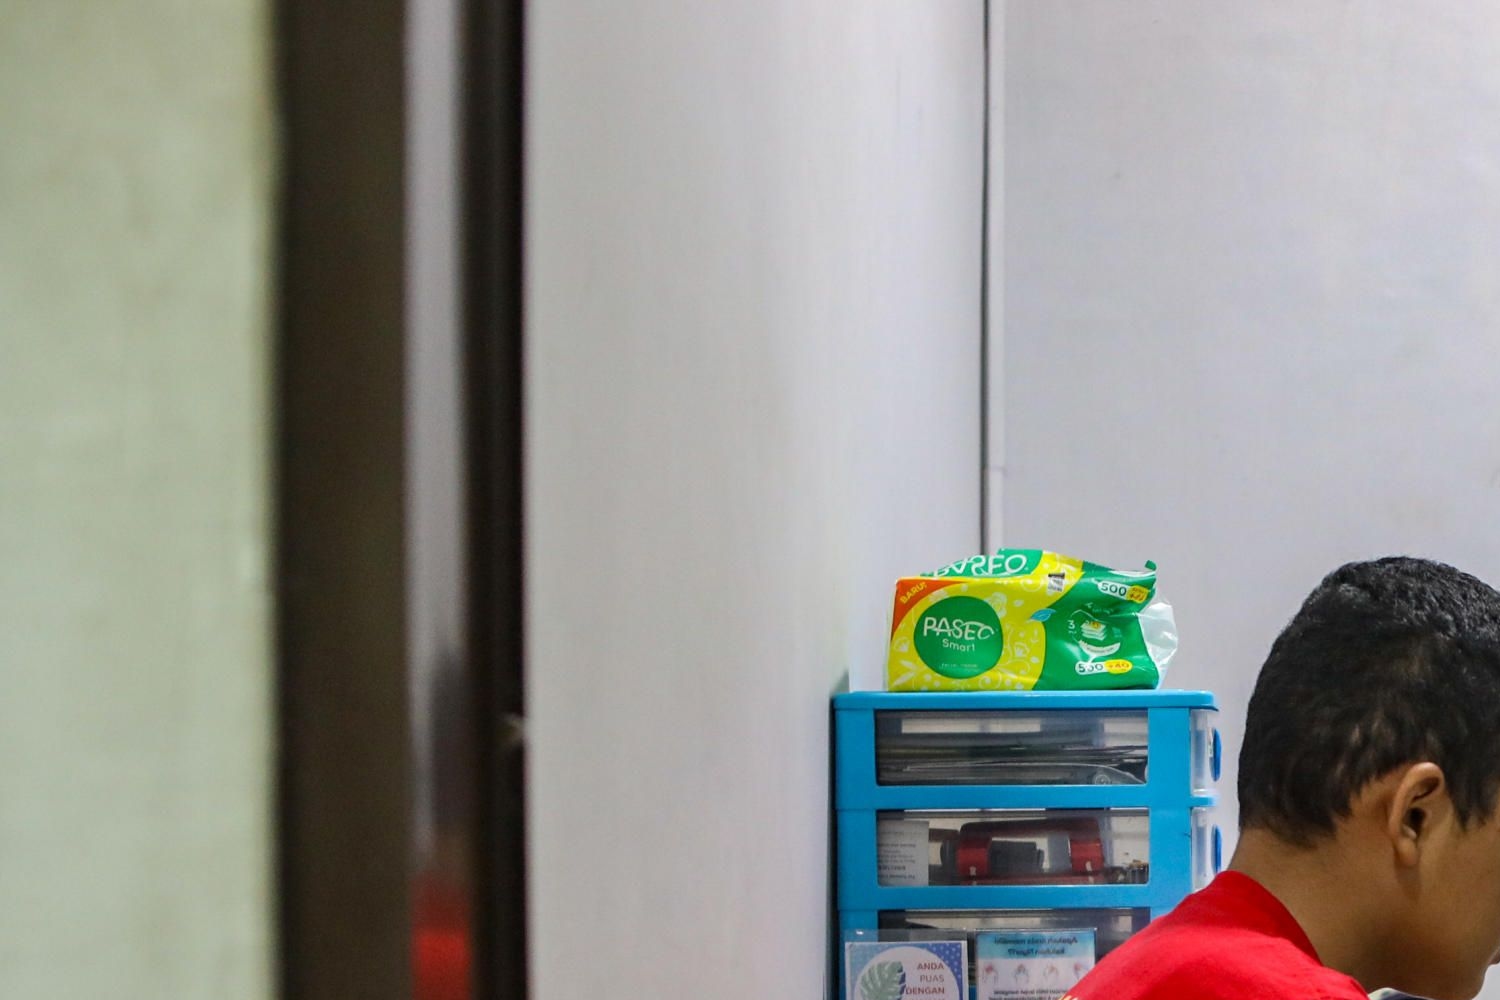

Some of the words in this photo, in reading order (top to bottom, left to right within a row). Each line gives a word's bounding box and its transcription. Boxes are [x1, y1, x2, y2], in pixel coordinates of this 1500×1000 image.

[1100, 582, 1127, 597] 500
[942, 638, 976, 652] Smart
[906, 987, 945, 995] DENGAN
